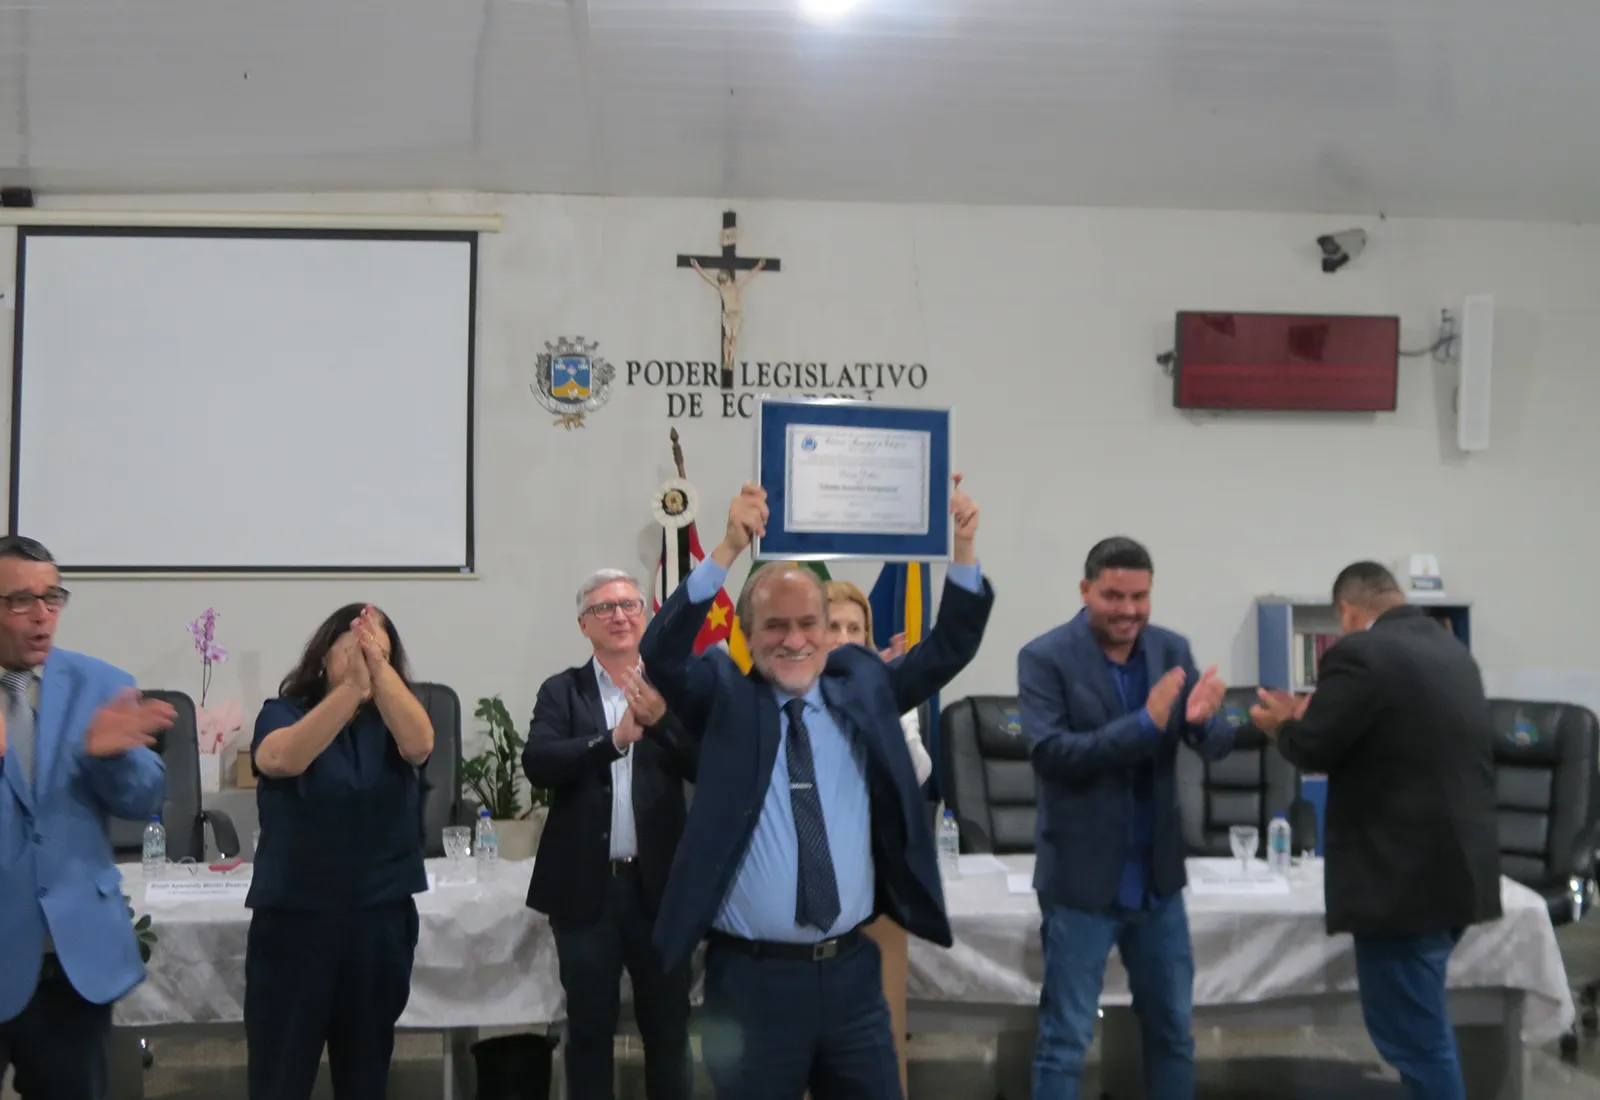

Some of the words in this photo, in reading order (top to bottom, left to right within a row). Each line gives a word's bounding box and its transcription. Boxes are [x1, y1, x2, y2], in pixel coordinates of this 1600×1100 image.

[626, 359, 720, 387] PODER
[740, 361, 928, 389] LEGISLATIVO
[667, 392, 704, 418] DE
